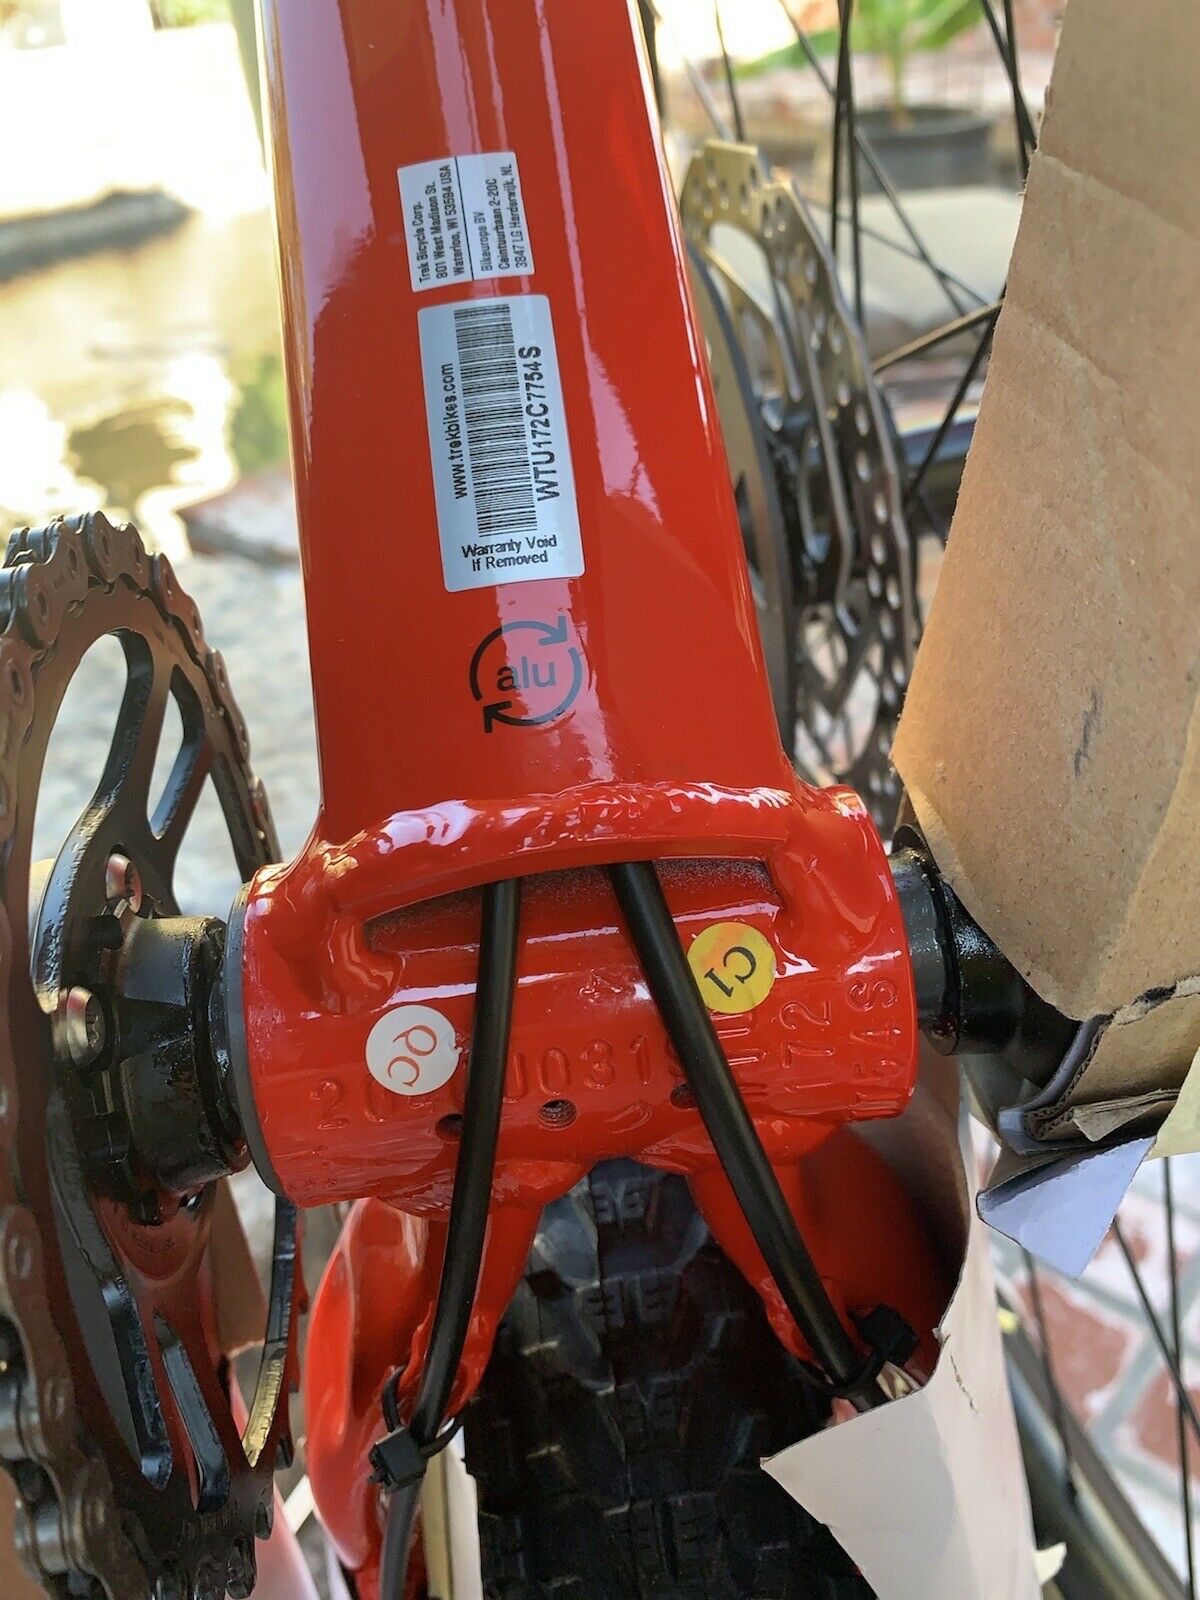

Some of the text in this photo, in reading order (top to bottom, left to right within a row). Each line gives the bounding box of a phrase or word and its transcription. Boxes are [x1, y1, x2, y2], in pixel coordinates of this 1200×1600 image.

[439, 165, 453, 185] USA
[501, 164, 513, 176] NL
[442, 186, 457, 217] 53594
[425, 181, 448, 279] 801 West Madison St.
[447, 218, 459, 231] WI
[473, 211, 493, 271] Bikeurope BV
[510, 230, 524, 243] LG
[412, 202, 430, 283] Trek Bicycle Corp.
[513, 244, 528, 268] 3847
[440, 363, 468, 499] www.trekbikes.com
[518, 346, 560, 501] WTU172C7754S
[461, 534, 558, 558] Warranty Void
[471, 550, 549, 572] If Removed
[496, 655, 557, 691] alu
[703, 946, 757, 998] C1
[387, 1024, 438, 1088] QC
